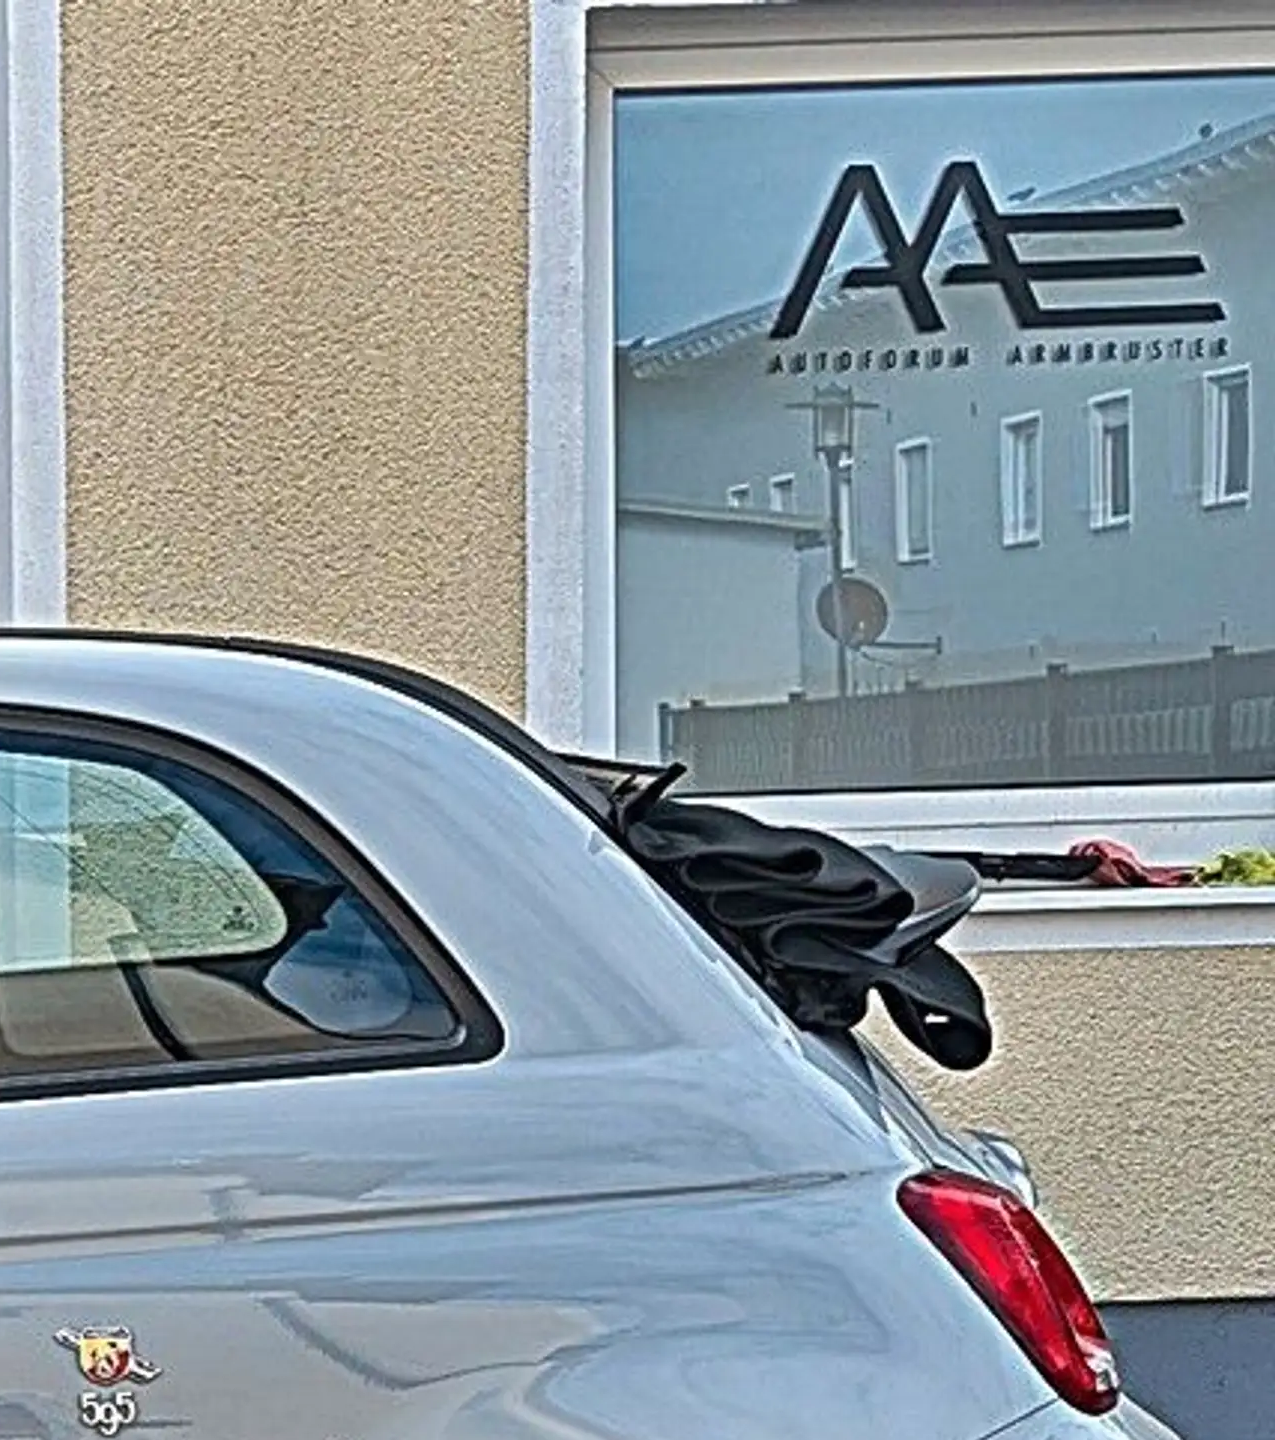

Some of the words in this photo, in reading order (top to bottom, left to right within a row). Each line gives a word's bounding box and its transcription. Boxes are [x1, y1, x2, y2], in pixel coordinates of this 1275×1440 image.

[767, 346, 970, 374] AUTOFORUM
[1006, 337, 1228, 366] ARMBRUSTER
[79, 1391, 138, 1437] 595
